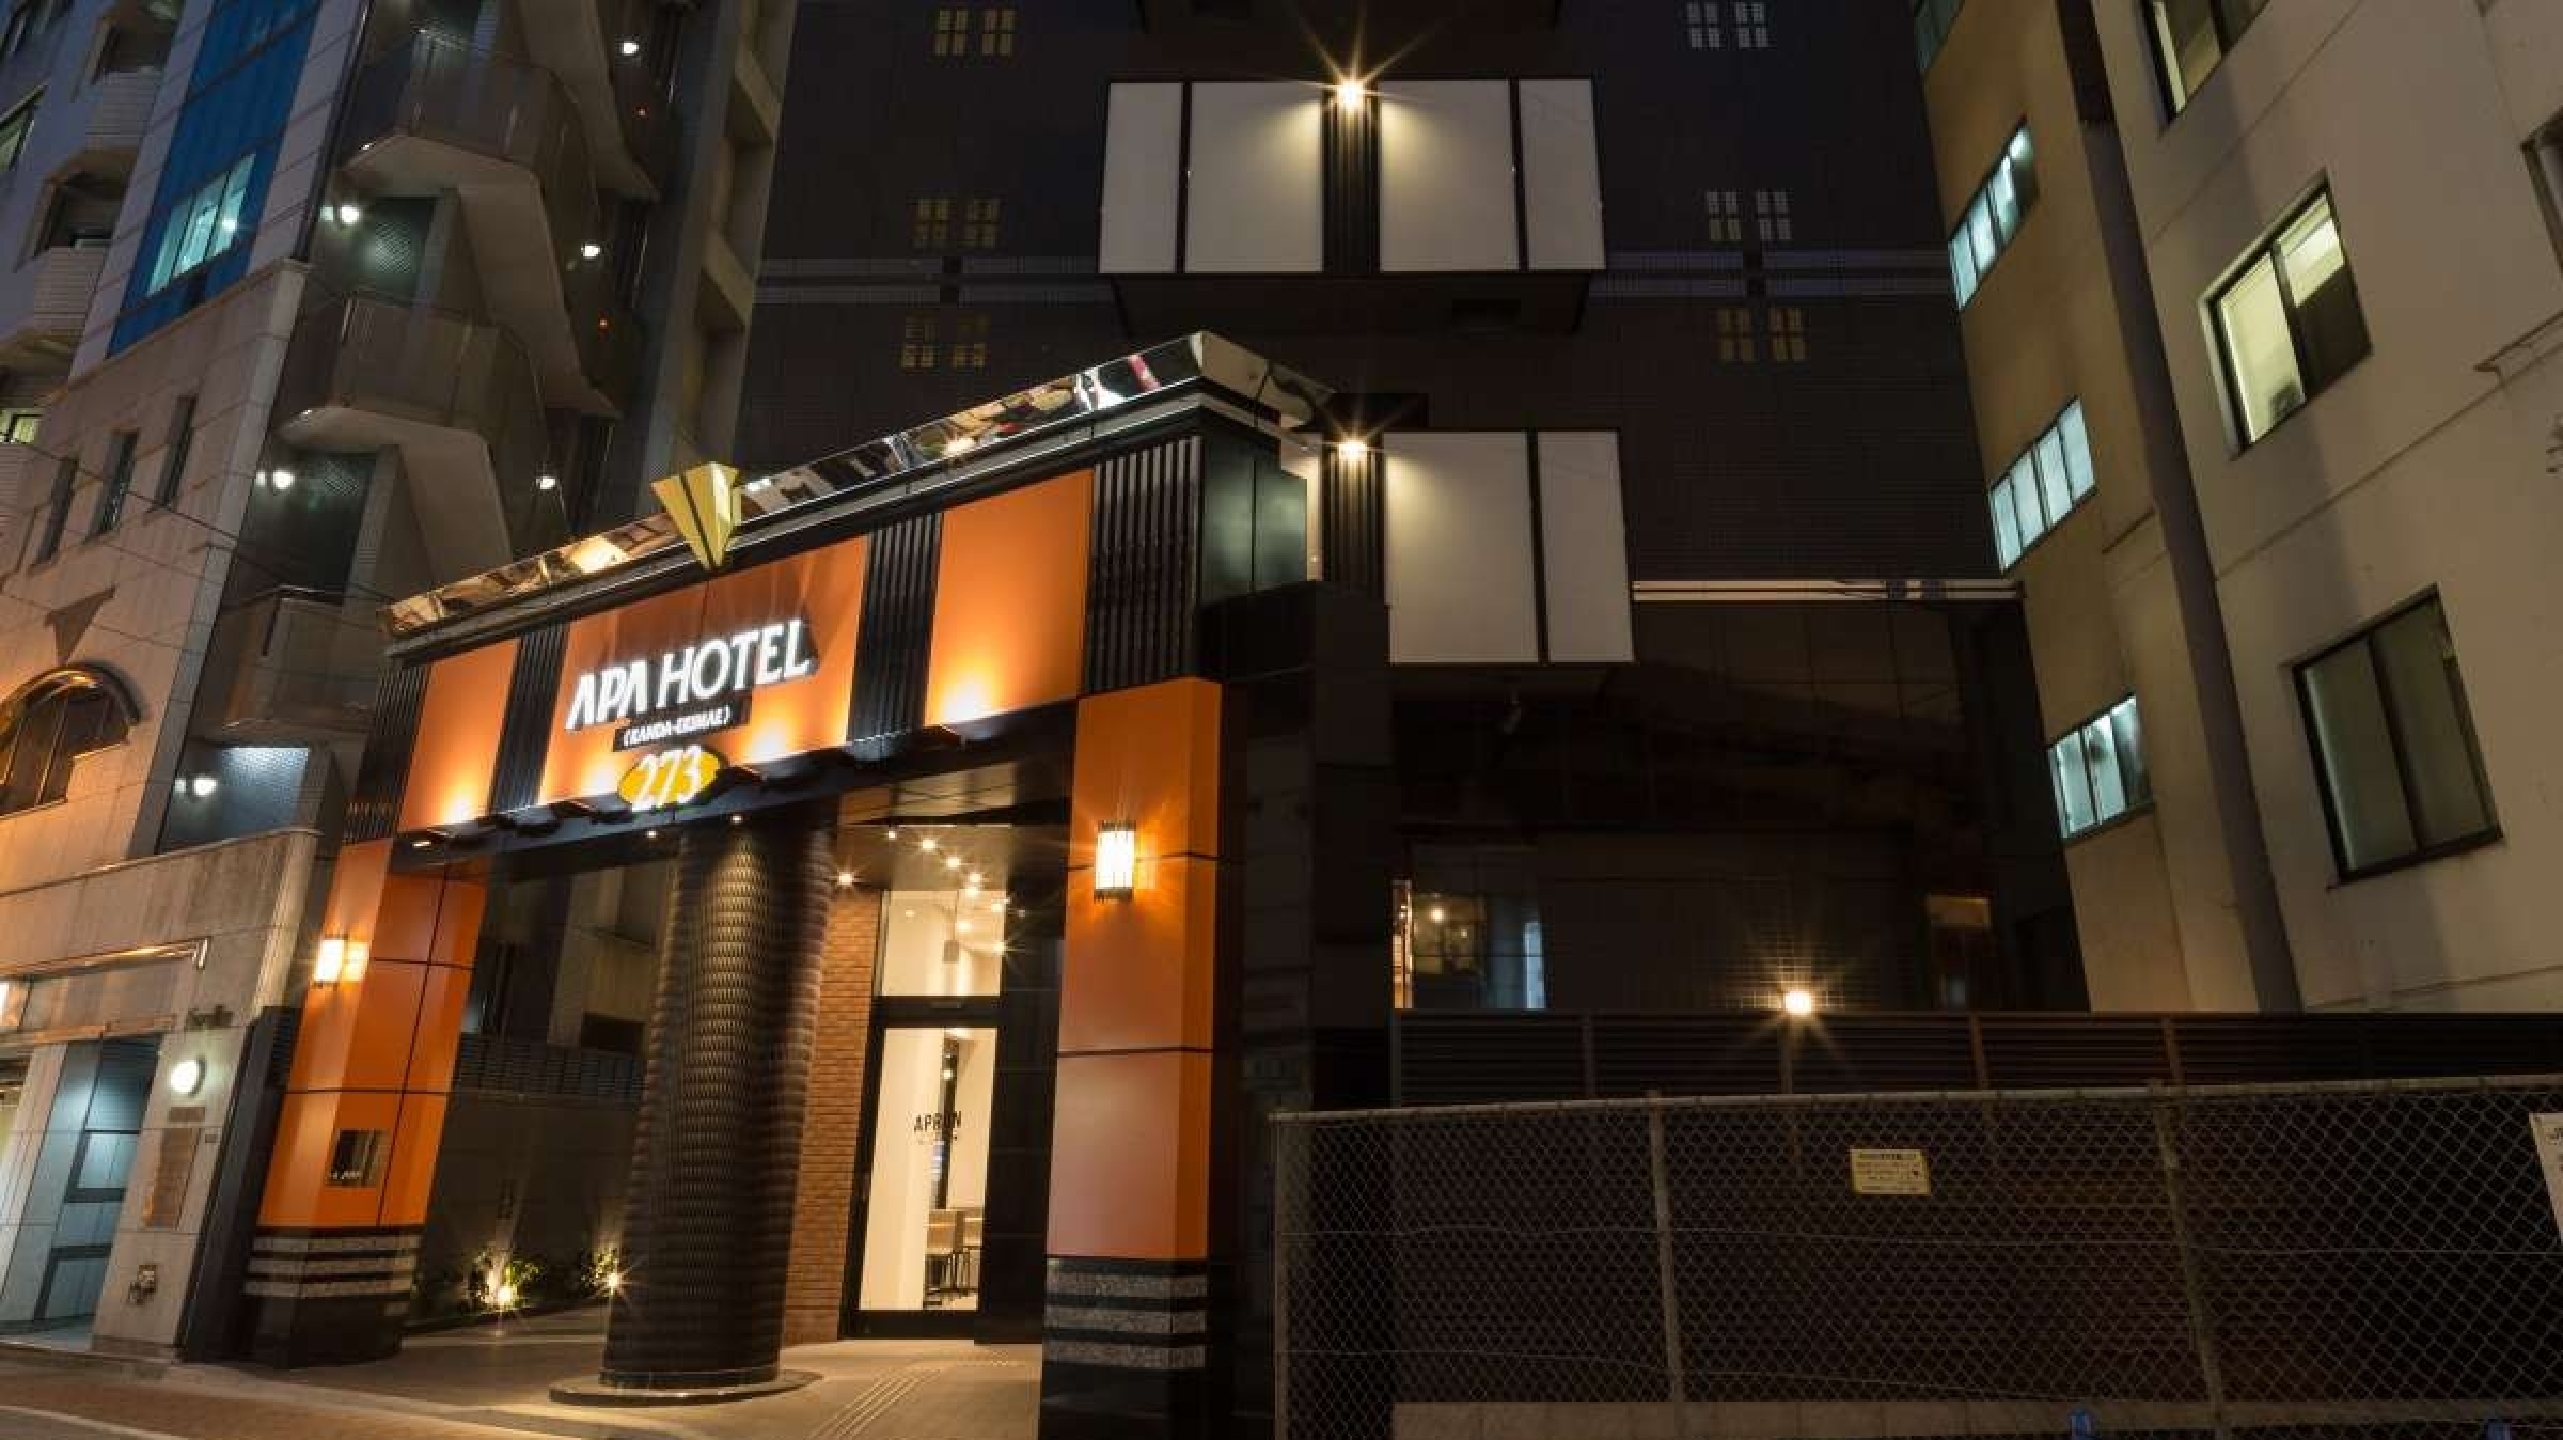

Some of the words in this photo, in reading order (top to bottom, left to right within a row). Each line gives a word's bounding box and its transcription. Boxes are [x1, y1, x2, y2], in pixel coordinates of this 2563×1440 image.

[565, 660, 648, 732] APA
[656, 619, 811, 708] HOTEL
[631, 744, 704, 812] 273
